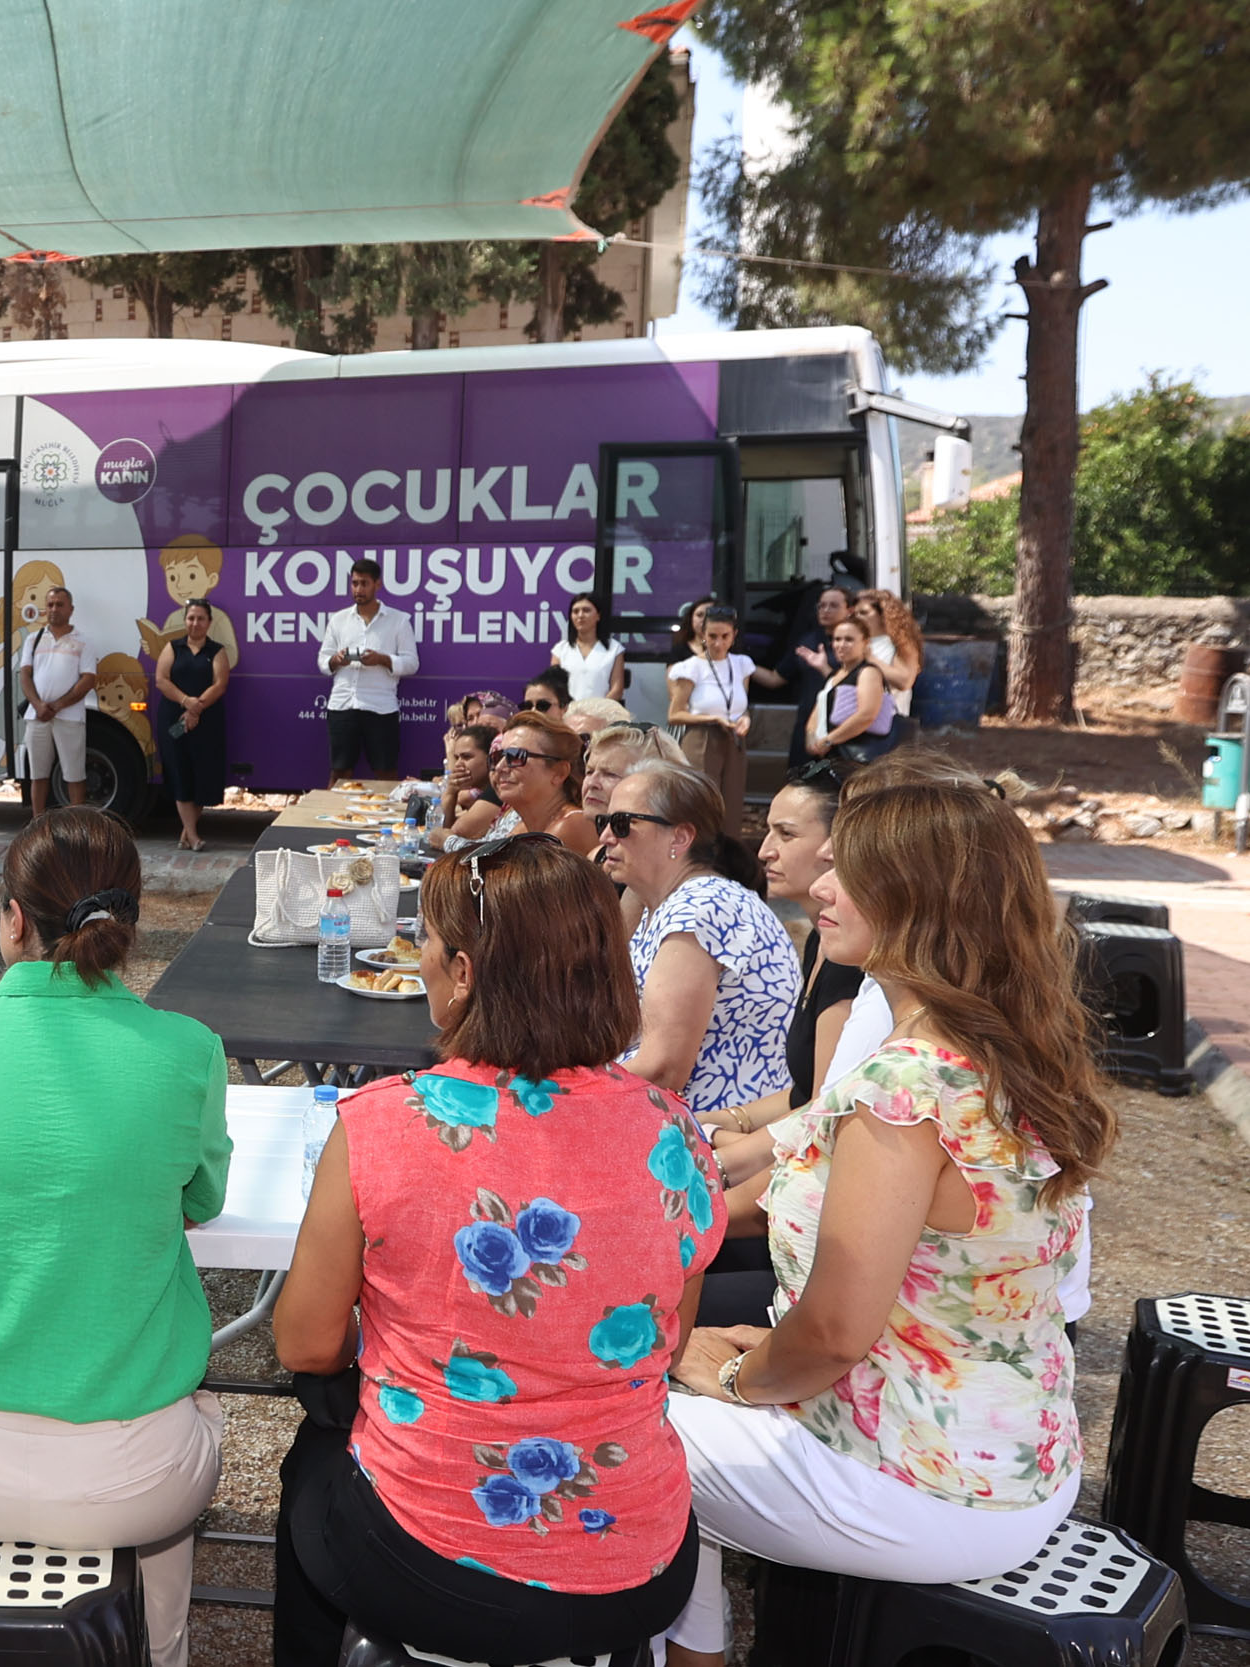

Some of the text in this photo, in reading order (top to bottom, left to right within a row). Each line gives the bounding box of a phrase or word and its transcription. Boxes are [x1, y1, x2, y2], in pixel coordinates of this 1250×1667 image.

[100, 470, 149, 485] KADIN
[243, 461, 660, 546] ÇOCUKLAR
[245, 545, 653, 612] KONUŞUYOR
[246, 611, 338, 643] KEN
[298, 711, 315, 720] 444
